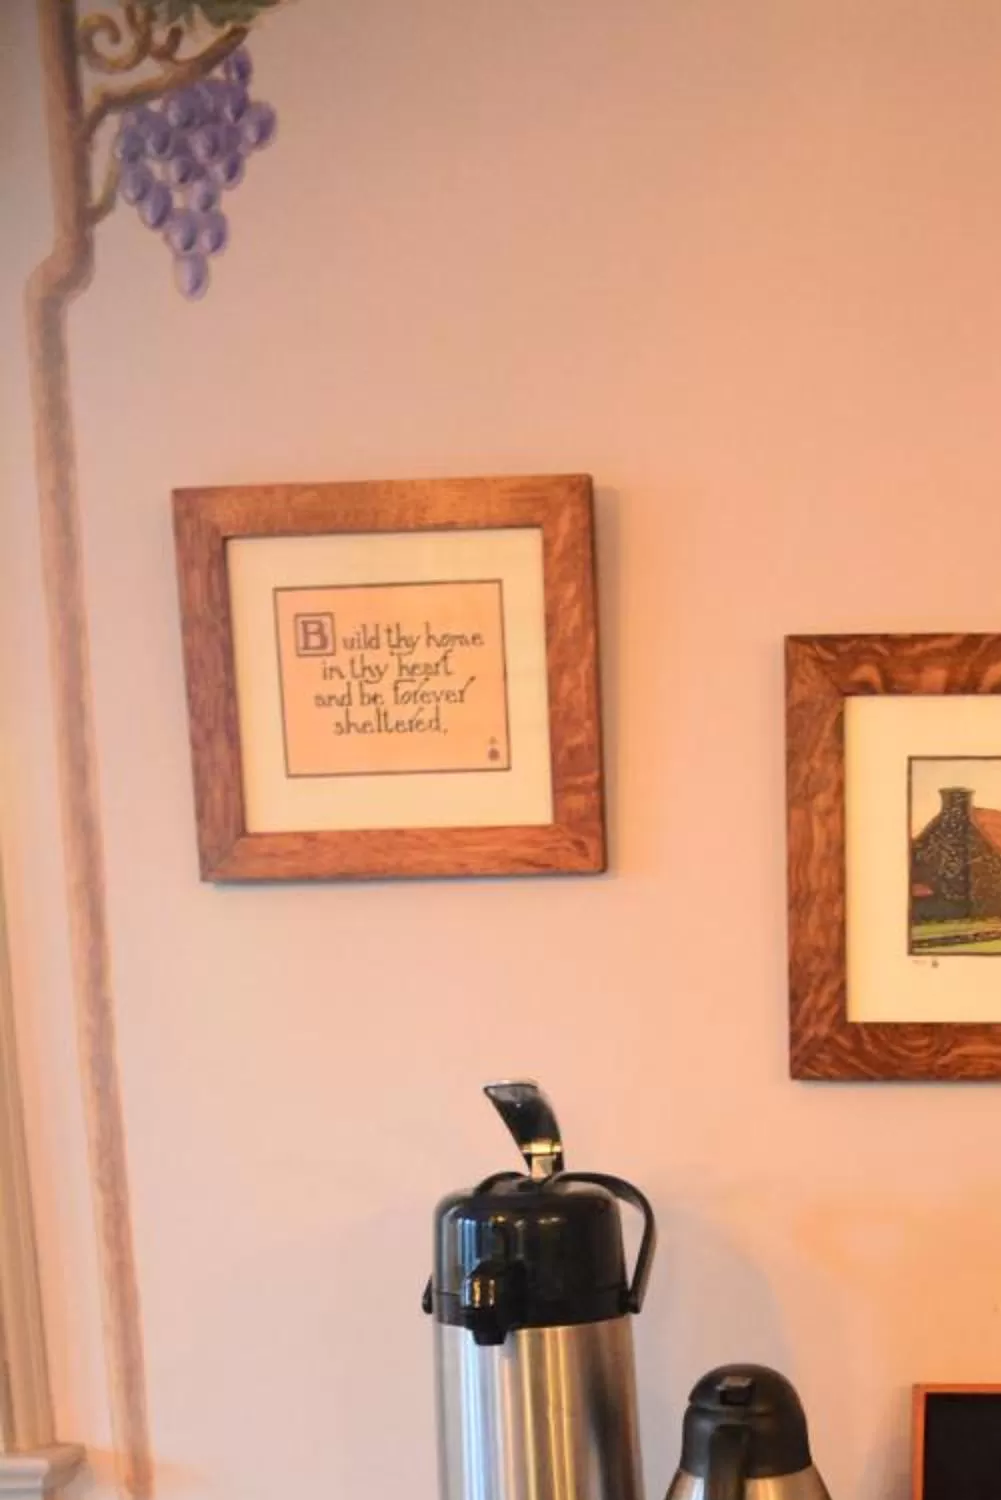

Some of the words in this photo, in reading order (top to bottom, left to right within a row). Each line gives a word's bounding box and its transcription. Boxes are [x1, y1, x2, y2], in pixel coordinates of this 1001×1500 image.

[386, 622, 419, 655] thy
[425, 620, 484, 648] home
[322, 660, 345, 681] in
[350, 654, 388, 684] thy
[397, 649, 453, 678] heart
[314, 681, 352, 708] and
[359, 680, 384, 707] be
[393, 676, 476, 705] forever
